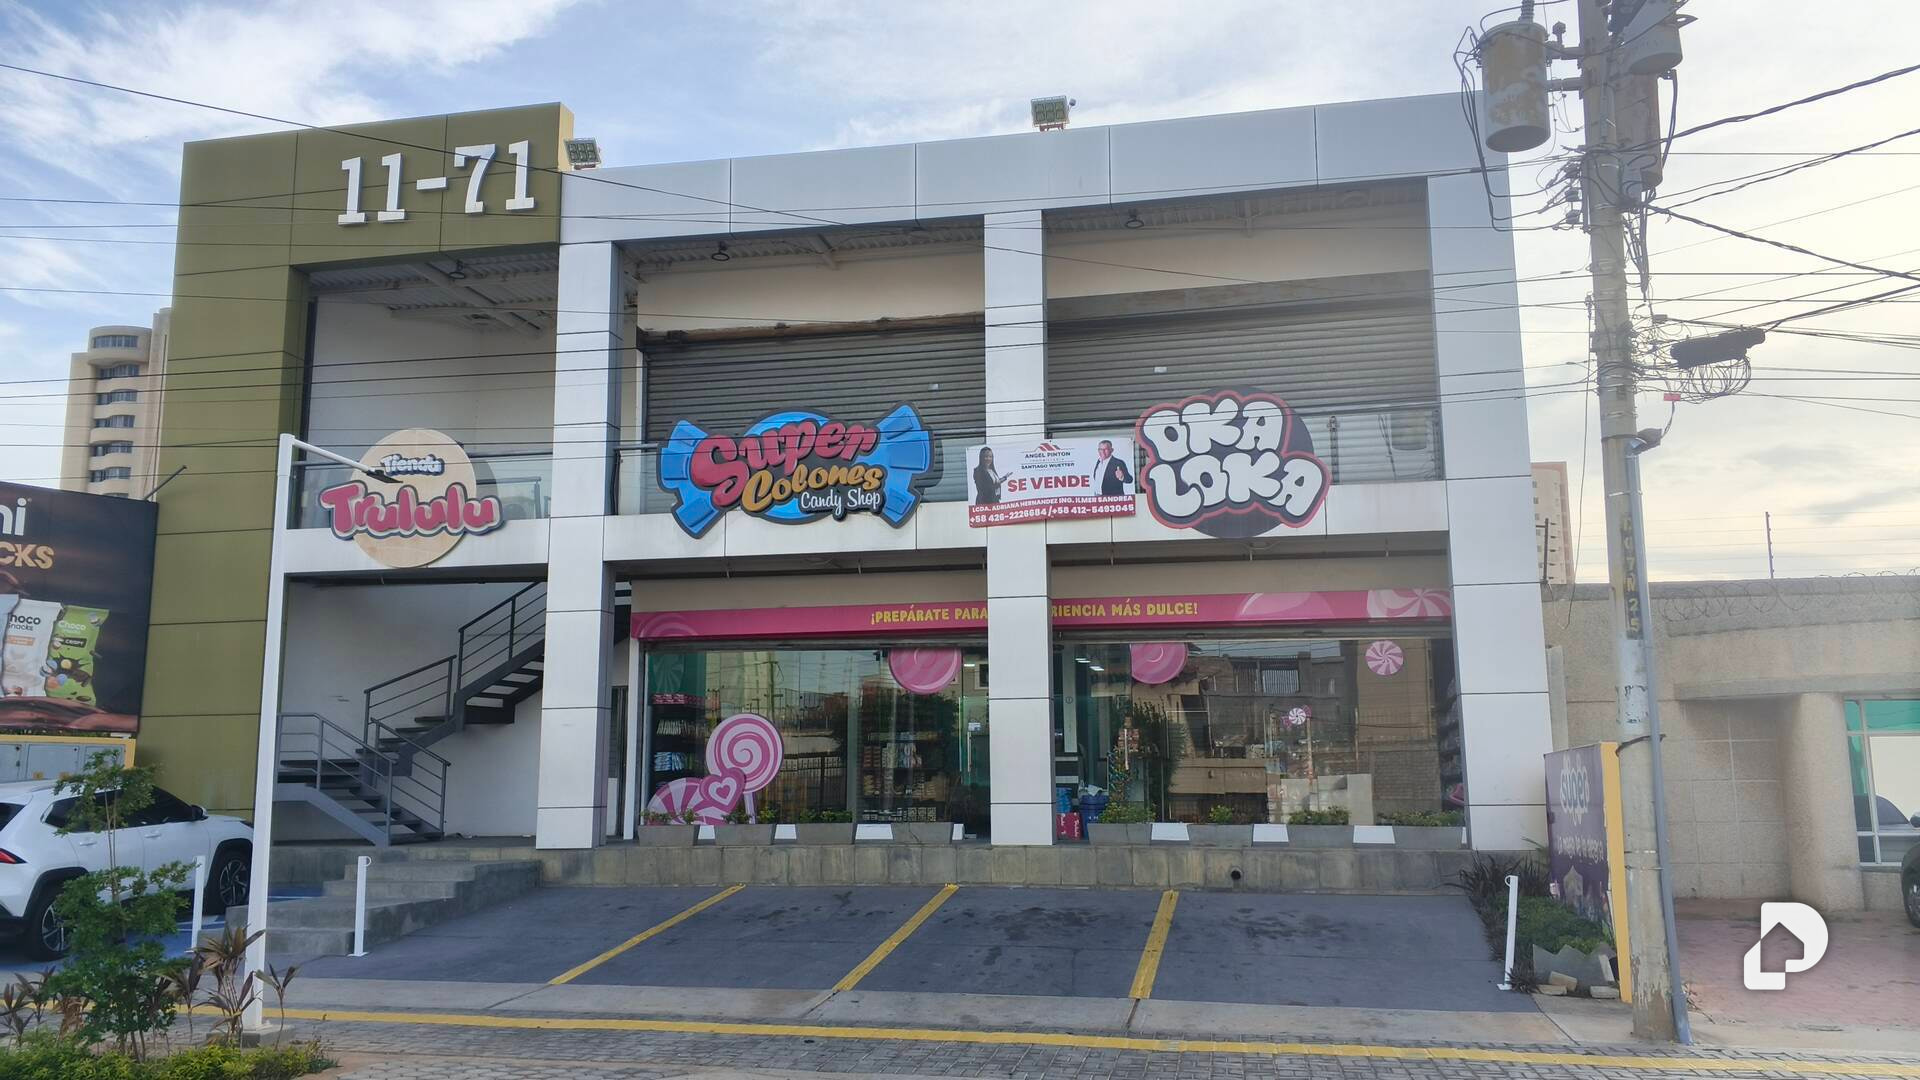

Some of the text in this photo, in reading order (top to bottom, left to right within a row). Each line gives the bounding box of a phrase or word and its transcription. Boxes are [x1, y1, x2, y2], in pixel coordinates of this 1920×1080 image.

[337, 139, 536, 226] 11-71
[1143, 398, 1284, 462] OKA
[380, 454, 445, 475] Tienda
[690, 420, 879, 508] Super
[741, 463, 884, 513] Colones
[1007, 474, 1090, 493] SE VENDE
[1149, 451, 1323, 518] LOKA
[319, 481, 501, 536] Trululu
[800, 487, 881, 517] Candy Shop
[992, 502, 1020, 511] ADRIANA
[871, 604, 950, 625] ¡PREPÁRATE
[954, 607, 988, 620] PARA
[1111, 598, 1141, 617] MÁS
[1146, 602, 1198, 616] DULCE!
